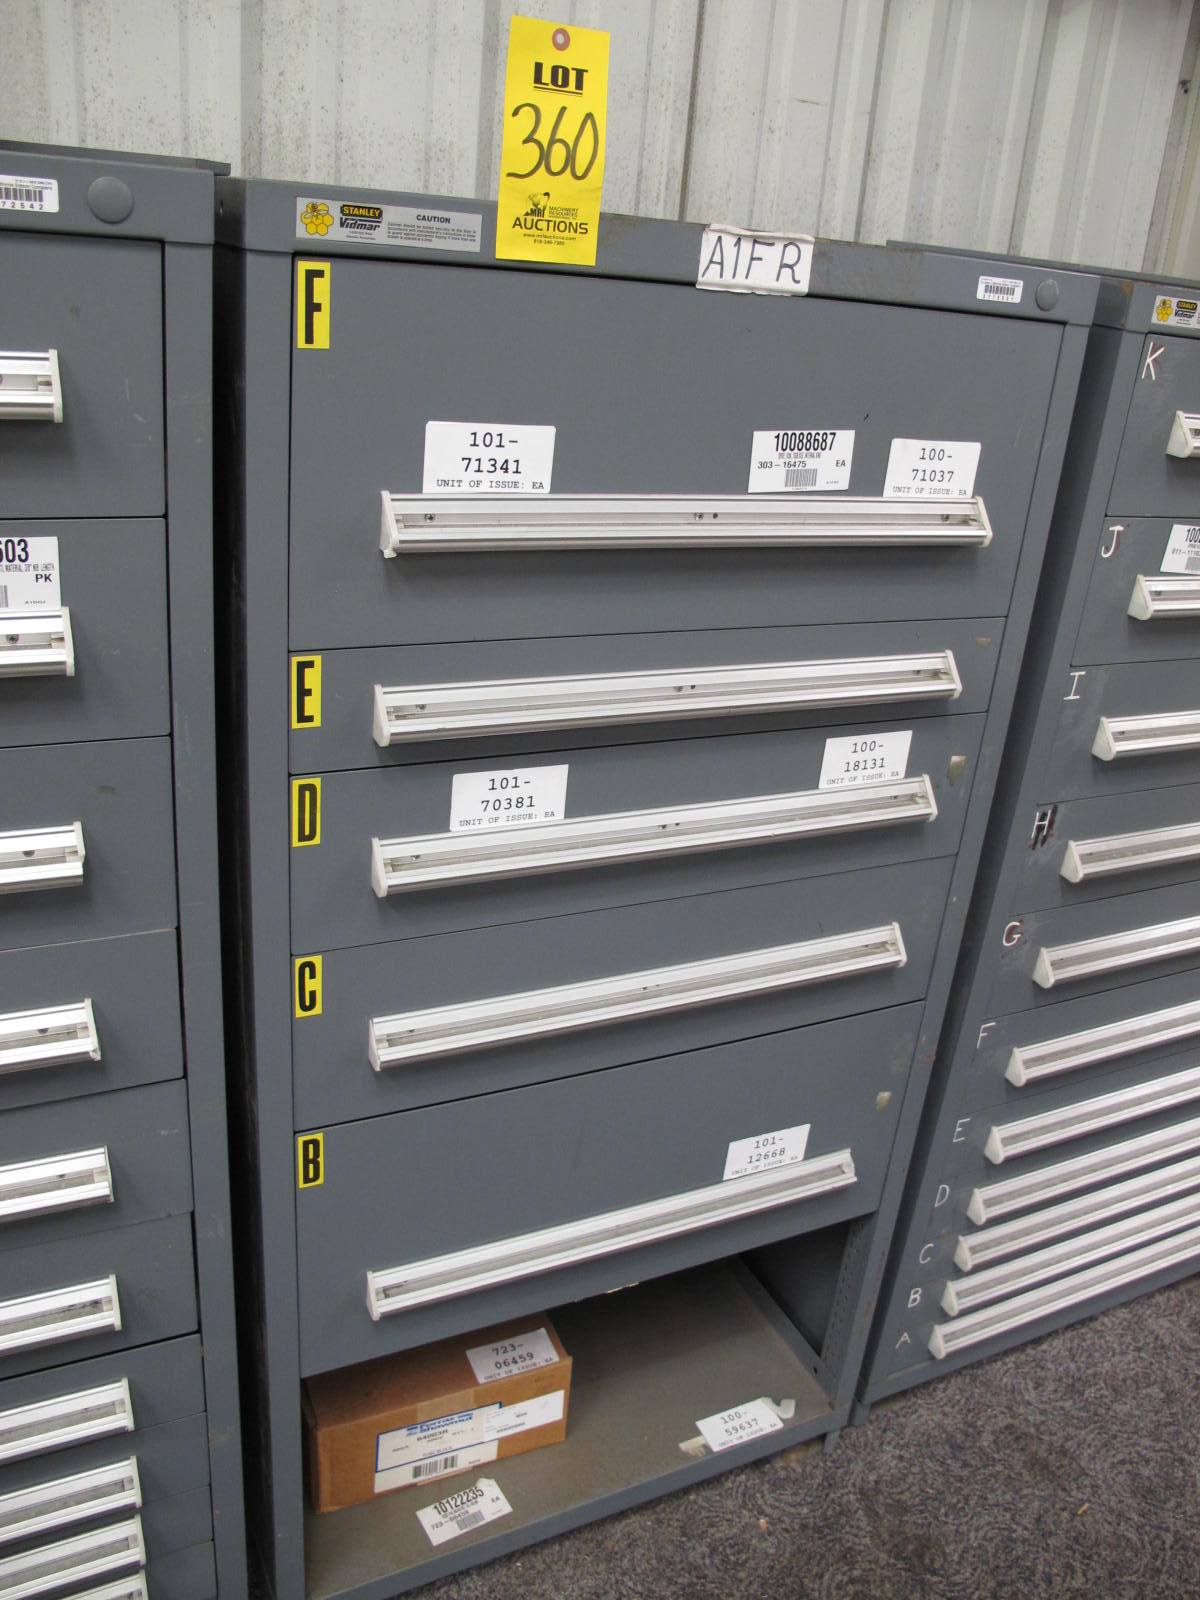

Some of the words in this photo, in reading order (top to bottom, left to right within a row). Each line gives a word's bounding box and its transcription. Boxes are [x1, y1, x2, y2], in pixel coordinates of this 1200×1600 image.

[533, 61, 589, 91] LOT
[506, 103, 599, 180] 360
[343, 206, 380, 217] STANLEY
[416, 214, 451, 224] CAUTION
[340, 217, 381, 231] Vidmar
[512, 217, 589, 235] AUCTIONS
[305, 269, 325, 344] F
[1141, 341, 1165, 380] K
[469, 432, 519, 448] 101-
[774, 432, 836, 452] 10088687
[919, 448, 953, 461] 100-
[461, 457, 522, 474] 71341
[835, 460, 846, 468] EA
[911, 468, 955, 482] 71037
[436, 479, 463, 488] UNIT
[468, 479, 483, 488] OF
[489, 480, 524, 489] ISSUE:
[532, 481, 545, 490] EA
[1101, 525, 1124, 558] J
[35, 573, 53, 583] PK
[297, 660, 315, 724] E
[851, 740, 885, 753] 100-
[844, 757, 886, 772] 18131
[488, 776, 531, 791] 101-
[298, 783, 317, 843] D
[481, 796, 535, 812] 70381
[459, 818, 483, 827] UNIT
[1032, 810, 1051, 839] H
[1003, 921, 1021, 946] G
[298, 961, 317, 1013] C
[977, 1022, 996, 1048] F
[952, 1118, 971, 1142] E
[754, 1136, 784, 1149] 101-
[302, 1138, 320, 1185] B
[747, 1147, 786, 1164] 12668
[935, 1185, 950, 1207] D
[919, 1244, 934, 1264] C
[908, 1288, 922, 1308] B
[896, 1332, 911, 1348] A
[492, 1343, 524, 1356] 723-
[494, 1352, 534, 1370] 06459
[720, 1411, 748, 1425] 100-
[724, 1418, 759, 1436] 59637
[433, 1486, 485, 1515] 10122235
